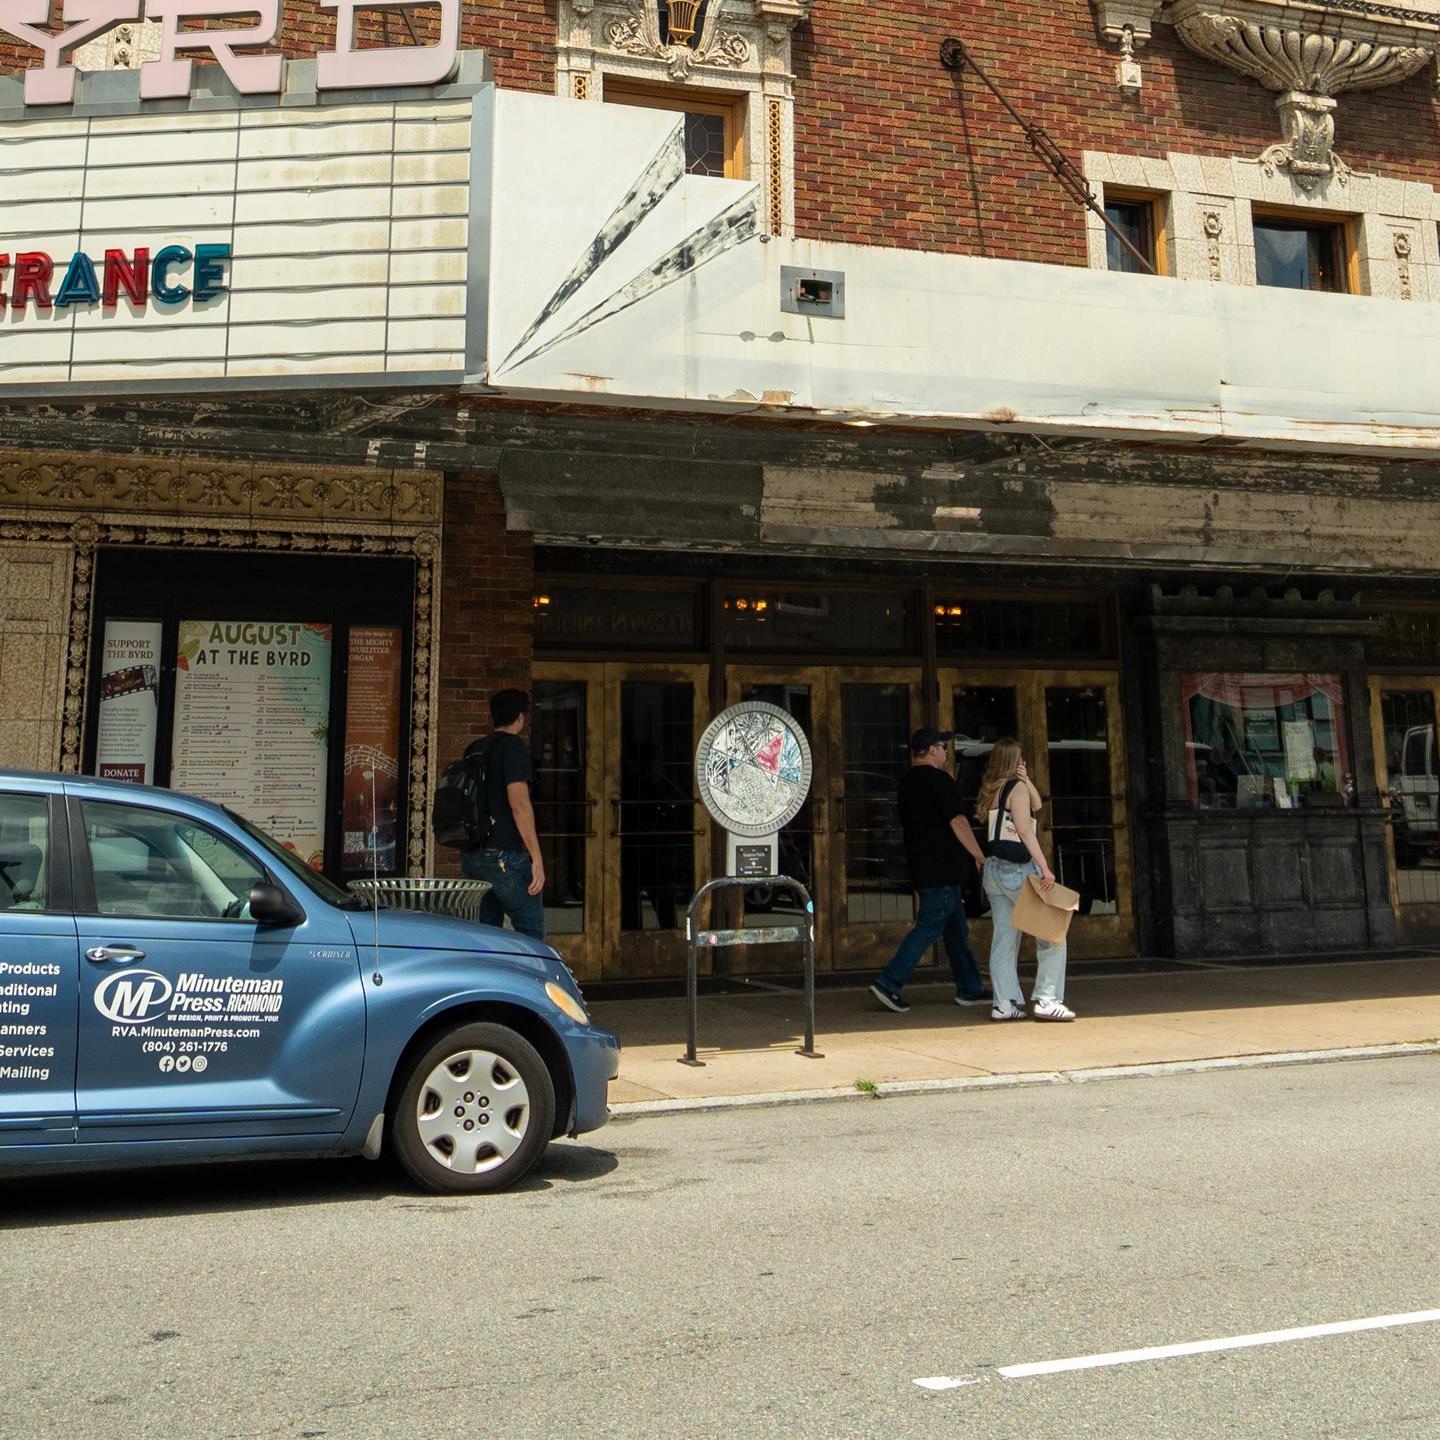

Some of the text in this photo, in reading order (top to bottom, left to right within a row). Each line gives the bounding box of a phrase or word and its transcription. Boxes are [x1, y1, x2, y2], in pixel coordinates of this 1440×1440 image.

[209, 622, 301, 646] AUGUST
[107, 639, 152, 648] SUPPORT
[107, 650, 154, 659] THE BYRD
[349, 646, 389, 655] WURLITZER
[196, 650, 311, 667] AT THE BYRD
[104, 769, 139, 778] DONATE
[0, 962, 61, 975] Products
[176, 974, 283, 994] Minuteman
[167, 1014, 177, 1022] WE
[178, 1014, 204, 1023] DESIGN,
[205, 1014, 223, 1022] PRINT
[112, 1026, 260, 1038] RVA.MinutemanPress.com
[142, 1041, 228, 1053] (804) 261-1776
[0, 1066, 50, 1080] Mailing
